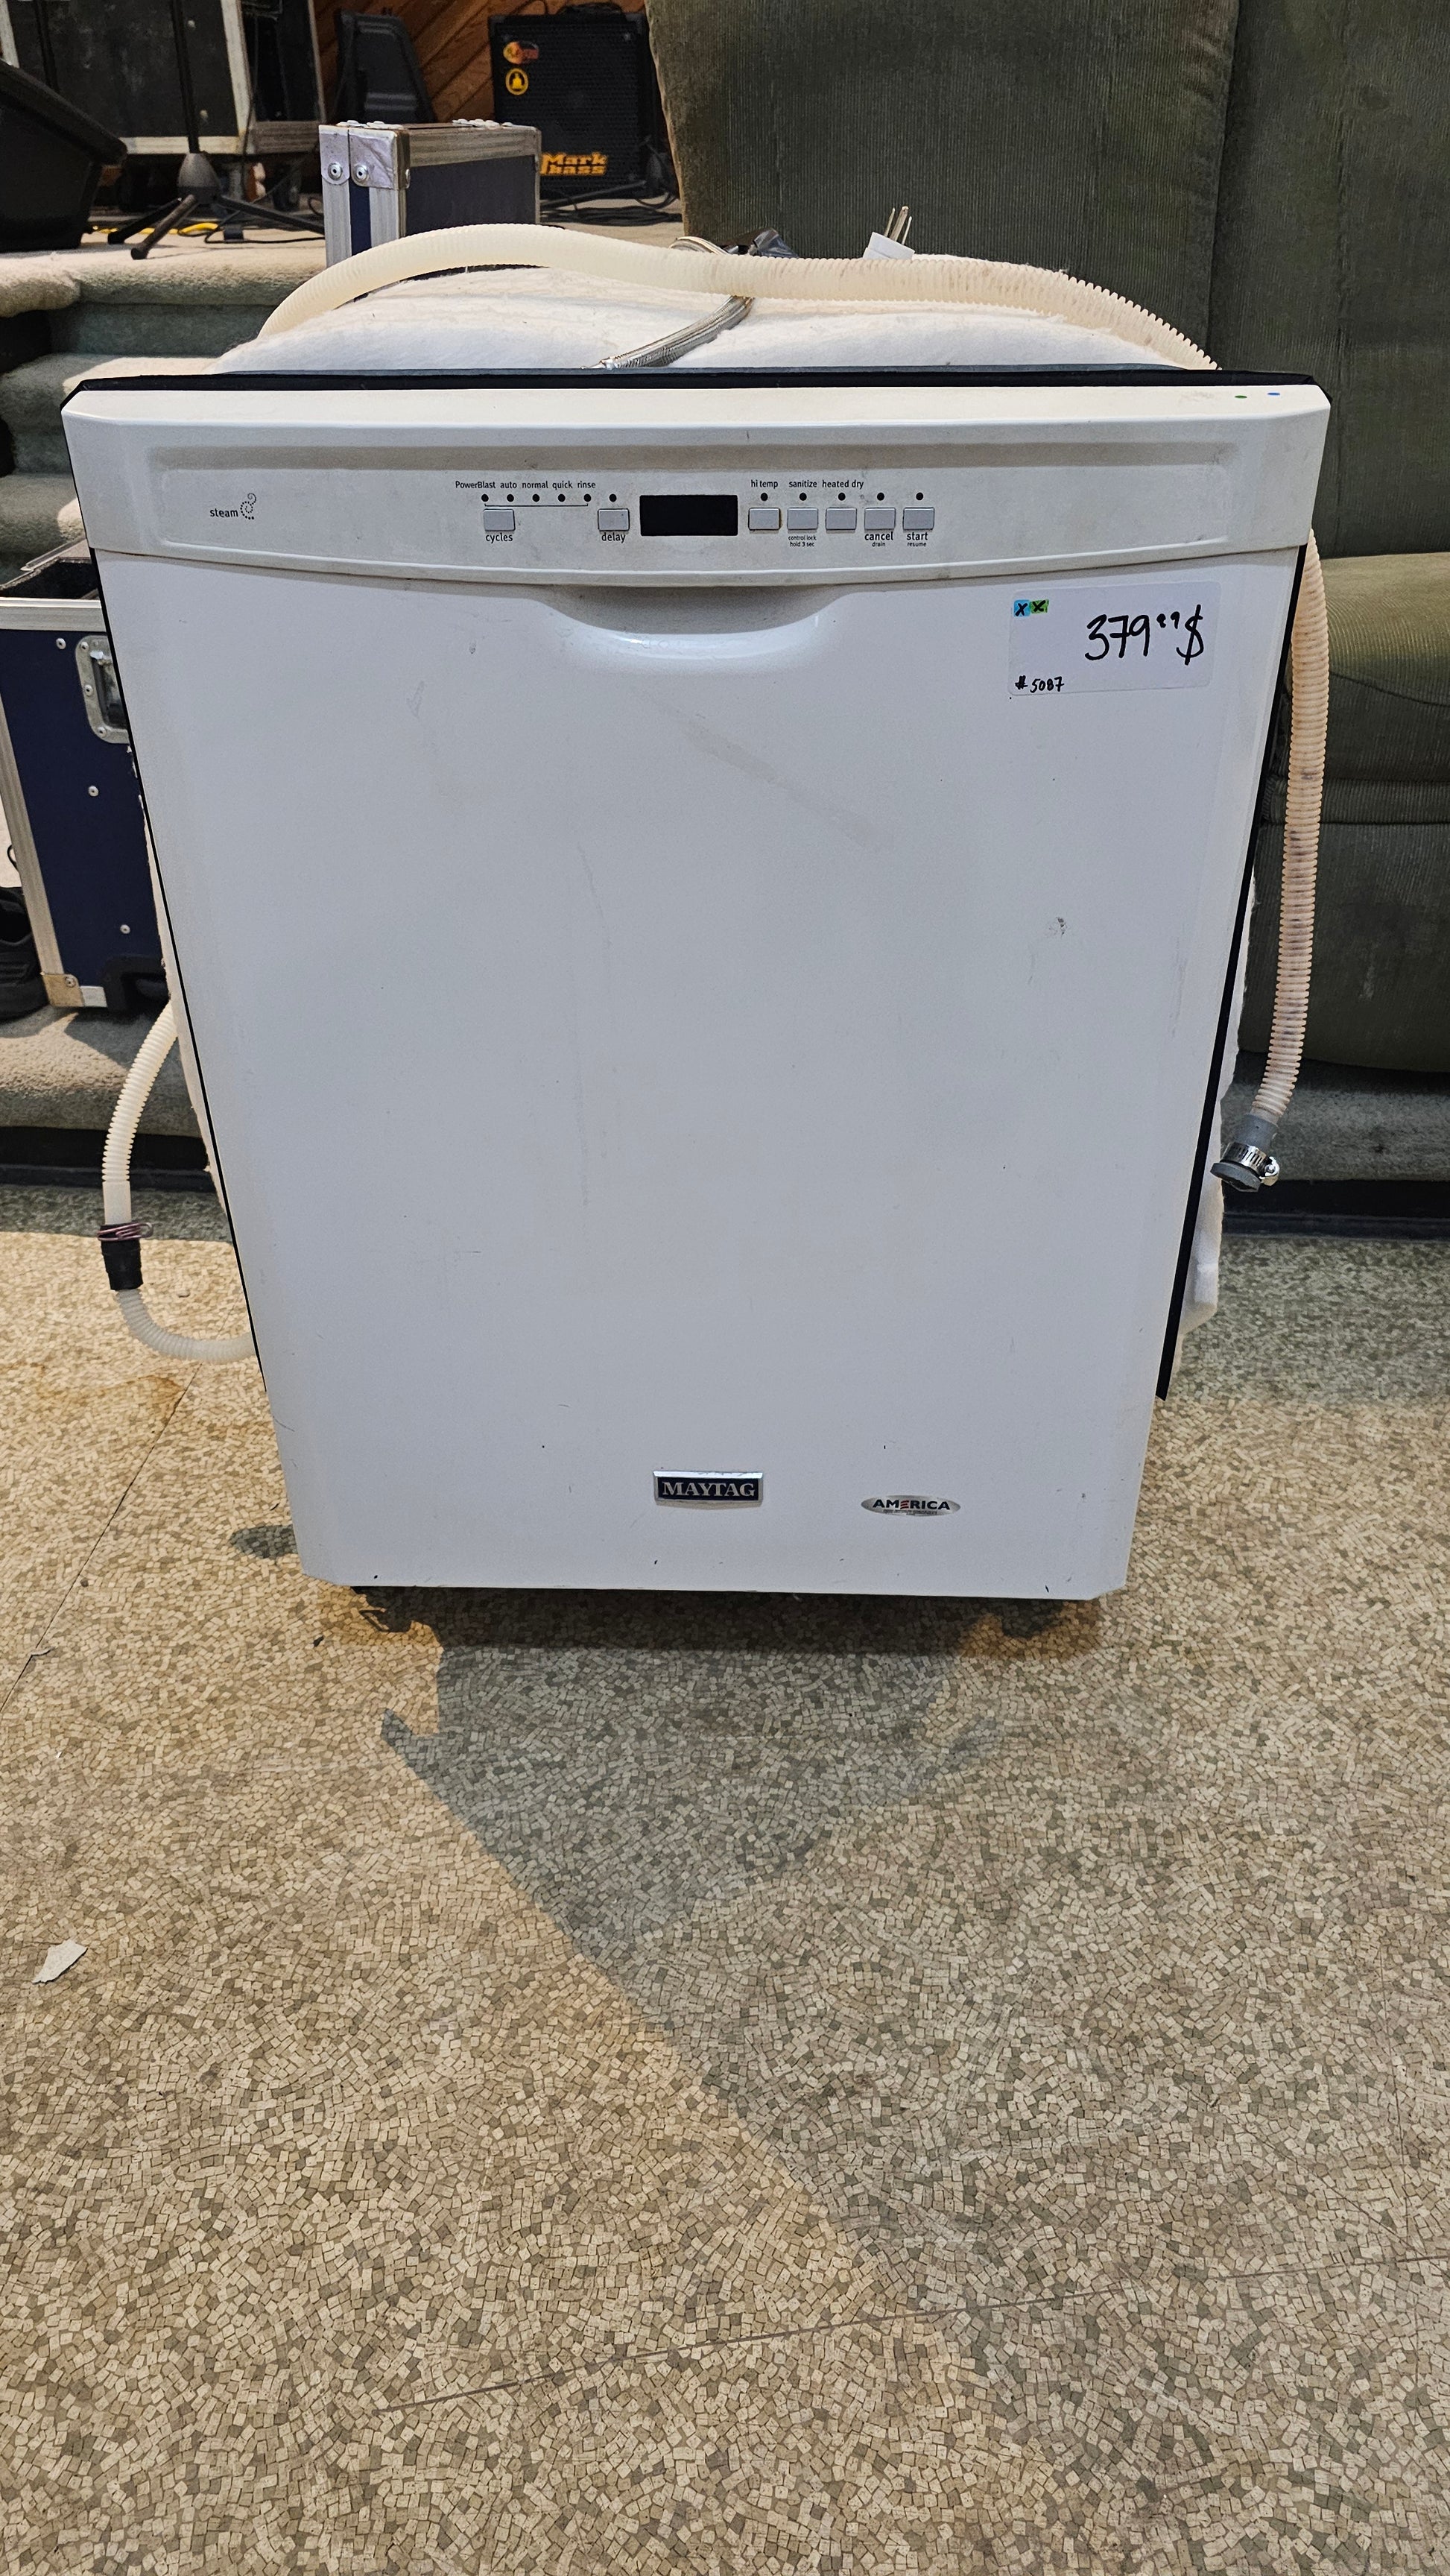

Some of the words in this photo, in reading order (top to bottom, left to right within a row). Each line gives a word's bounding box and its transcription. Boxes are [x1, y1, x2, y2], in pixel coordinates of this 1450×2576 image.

[540, 151, 607, 167] Mark
[455, 481, 496, 489] PowerBlast
[522, 481, 548, 489] normal
[552, 481, 573, 490] quick
[577, 481, 596, 489] rinse
[750, 480, 759, 488] hi
[759, 481, 779, 490] temp
[788, 480, 817, 488] sanitize
[822, 480, 849, 488] heated
[851, 480, 864, 490] dry
[209, 508, 238, 517] steam
[485, 532, 513, 543] cycles
[601, 532, 626, 543] delay
[864, 531, 894, 541] cancel
[906, 531, 928, 541] start
[662, 1481, 756, 1497] MAYTAG
[872, 1499, 951, 1510] AMERICA
